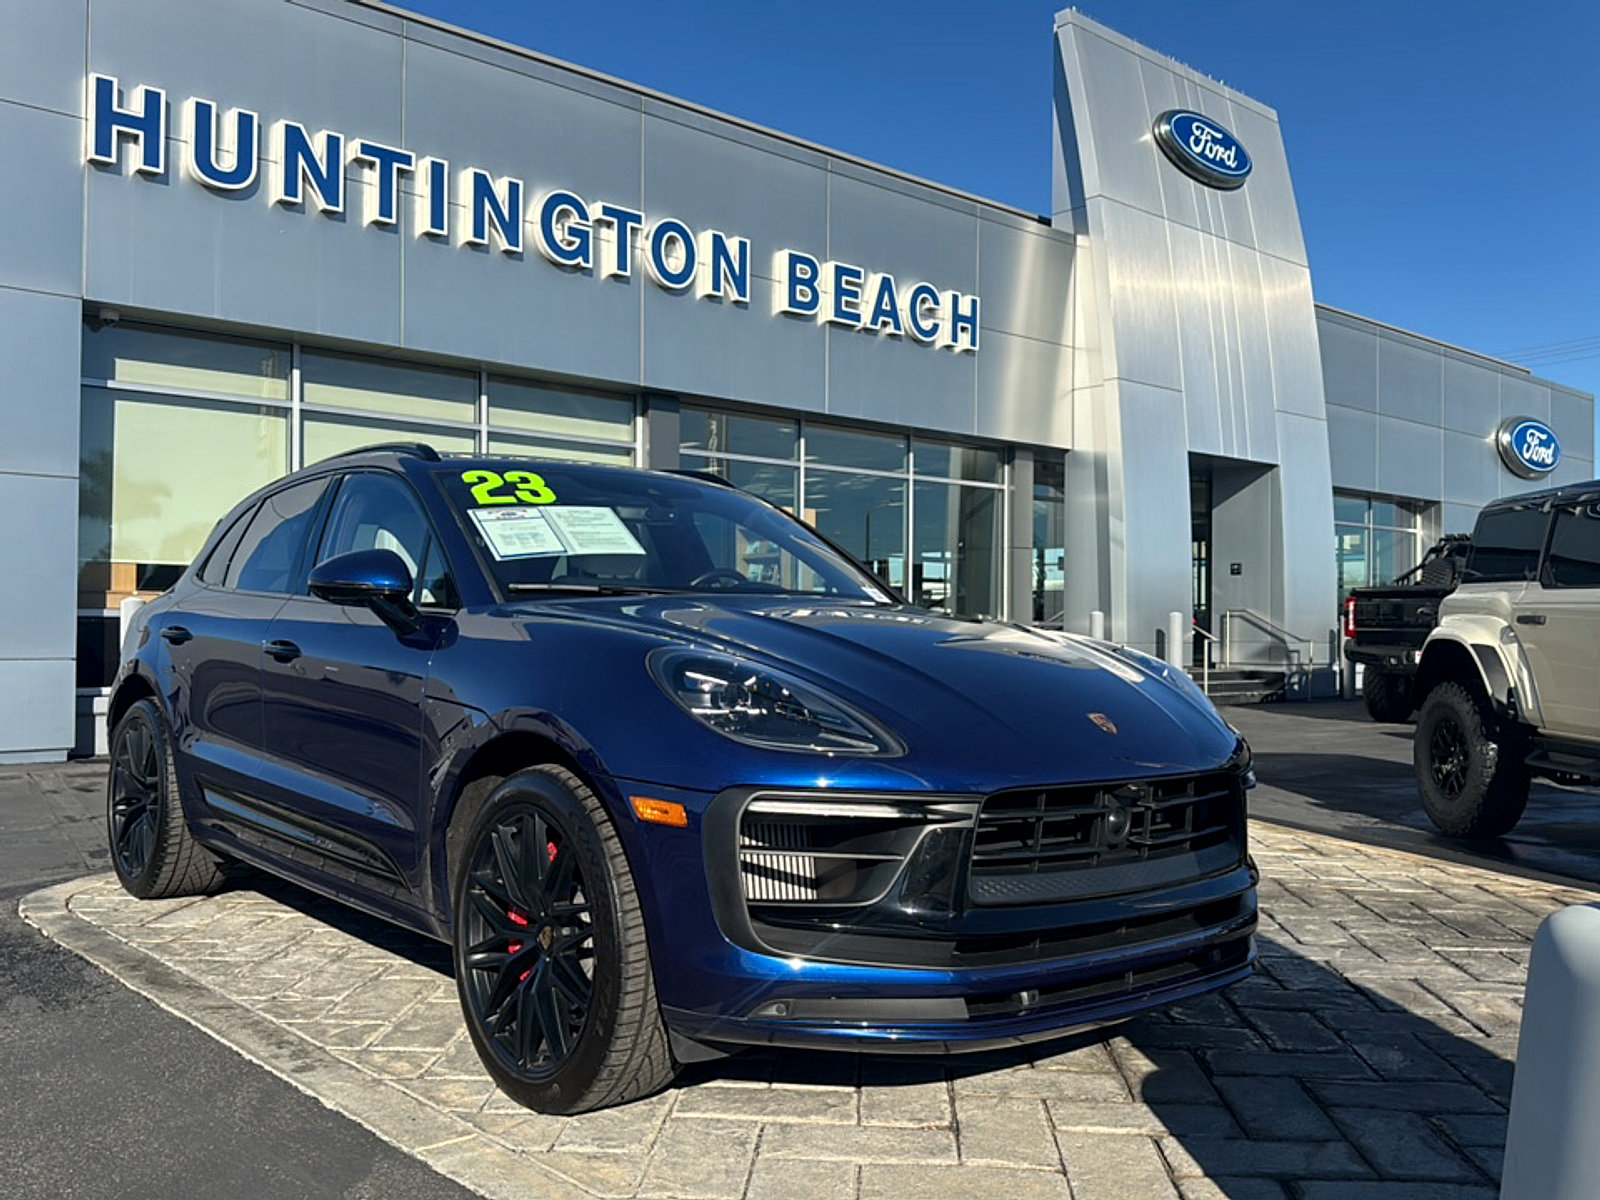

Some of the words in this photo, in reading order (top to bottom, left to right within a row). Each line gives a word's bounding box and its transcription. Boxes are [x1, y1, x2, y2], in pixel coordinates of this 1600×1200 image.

[1190, 121, 1238, 168] Ford
[87, 73, 751, 303] HUNTINGTON
[778, 249, 980, 351] BEACH
[1523, 428, 1555, 465] Ford
[461, 470, 556, 505] 23
